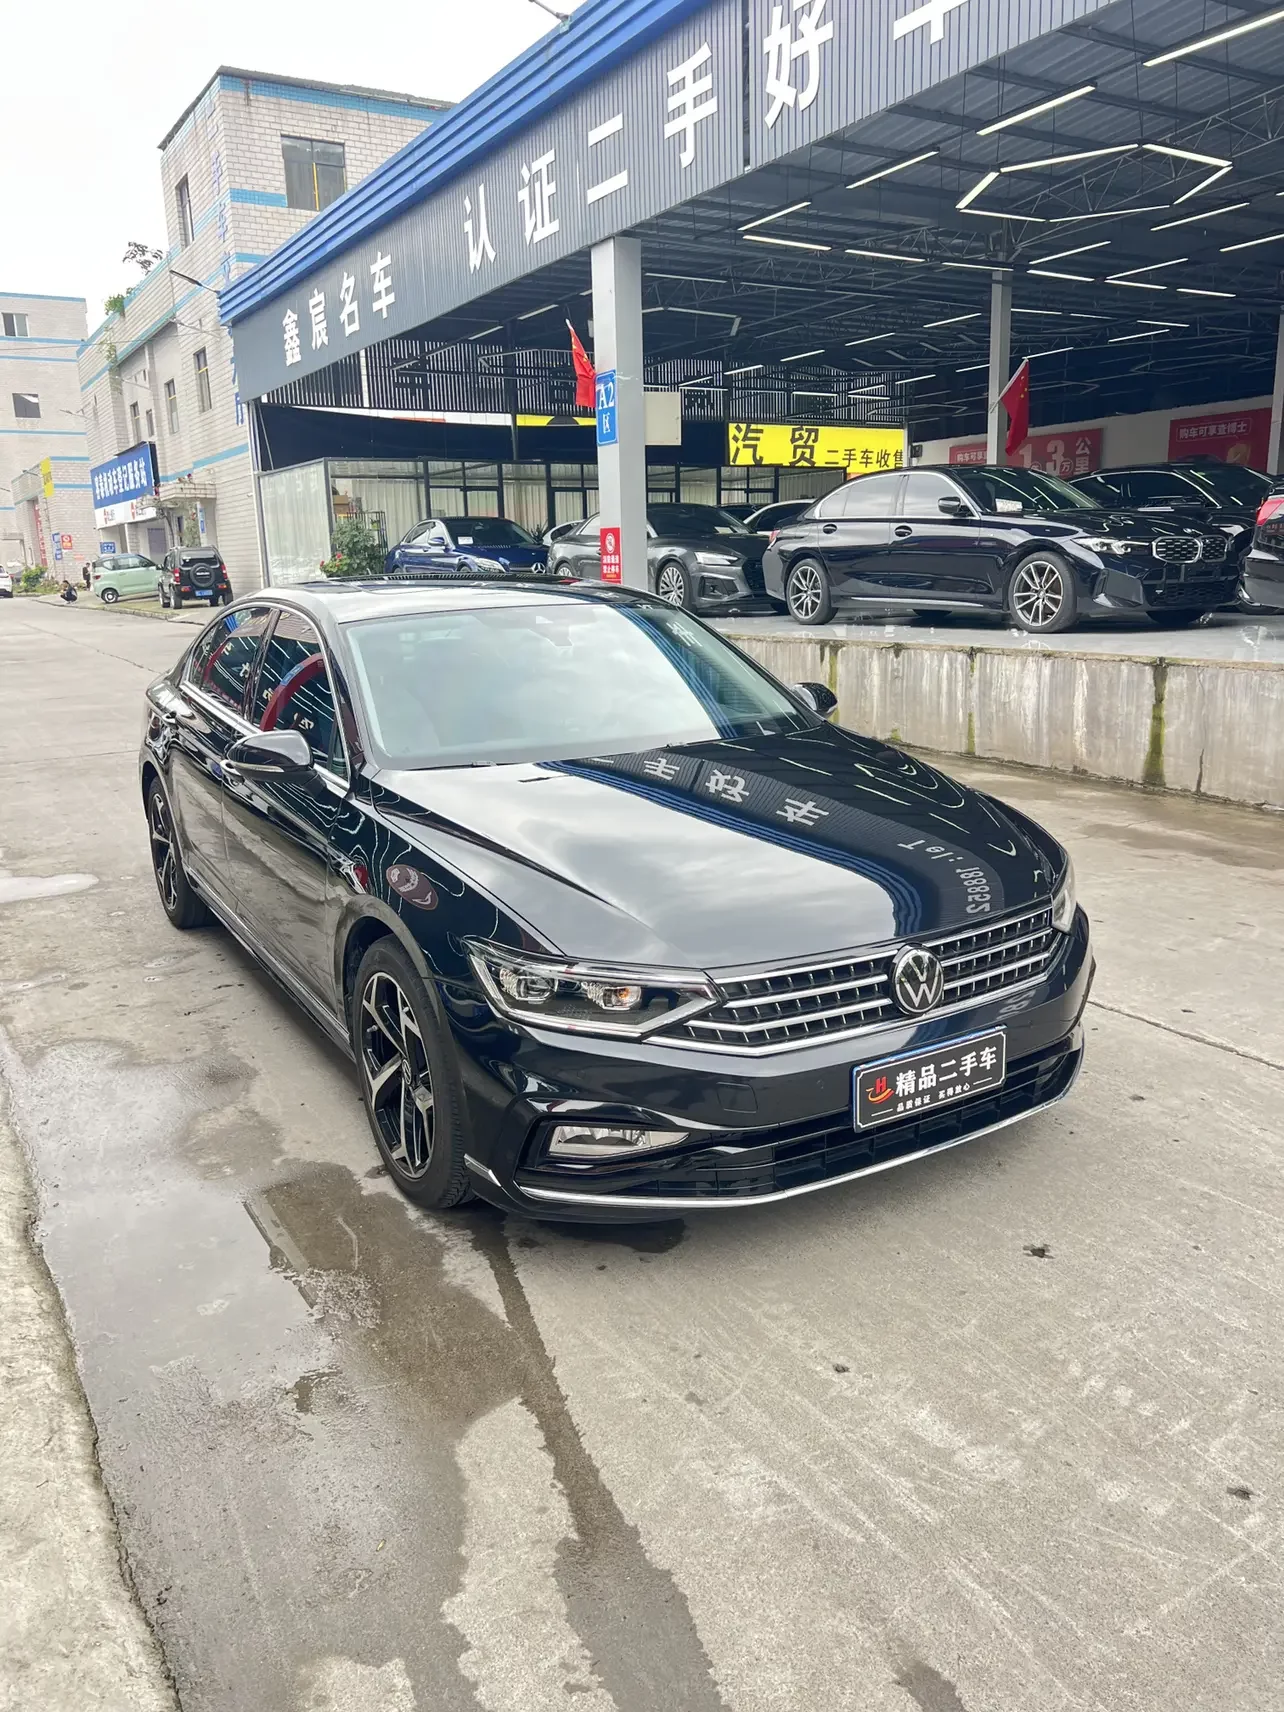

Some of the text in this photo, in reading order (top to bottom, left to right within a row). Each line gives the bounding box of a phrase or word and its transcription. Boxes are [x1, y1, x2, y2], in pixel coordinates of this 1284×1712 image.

[282, 251, 396, 367] 鑫宸名车
[598, 381, 616, 410] A2
[1179, 421, 1247, 439] 购车可享查博士
[731, 423, 819, 467] 汽贸
[956, 451, 987, 462] 购车可享
[825, 448, 903, 469] 二手车收售
[895, 1046, 997, 1098] 精品二手车
[938, 1083, 970, 1099] 买得放心
